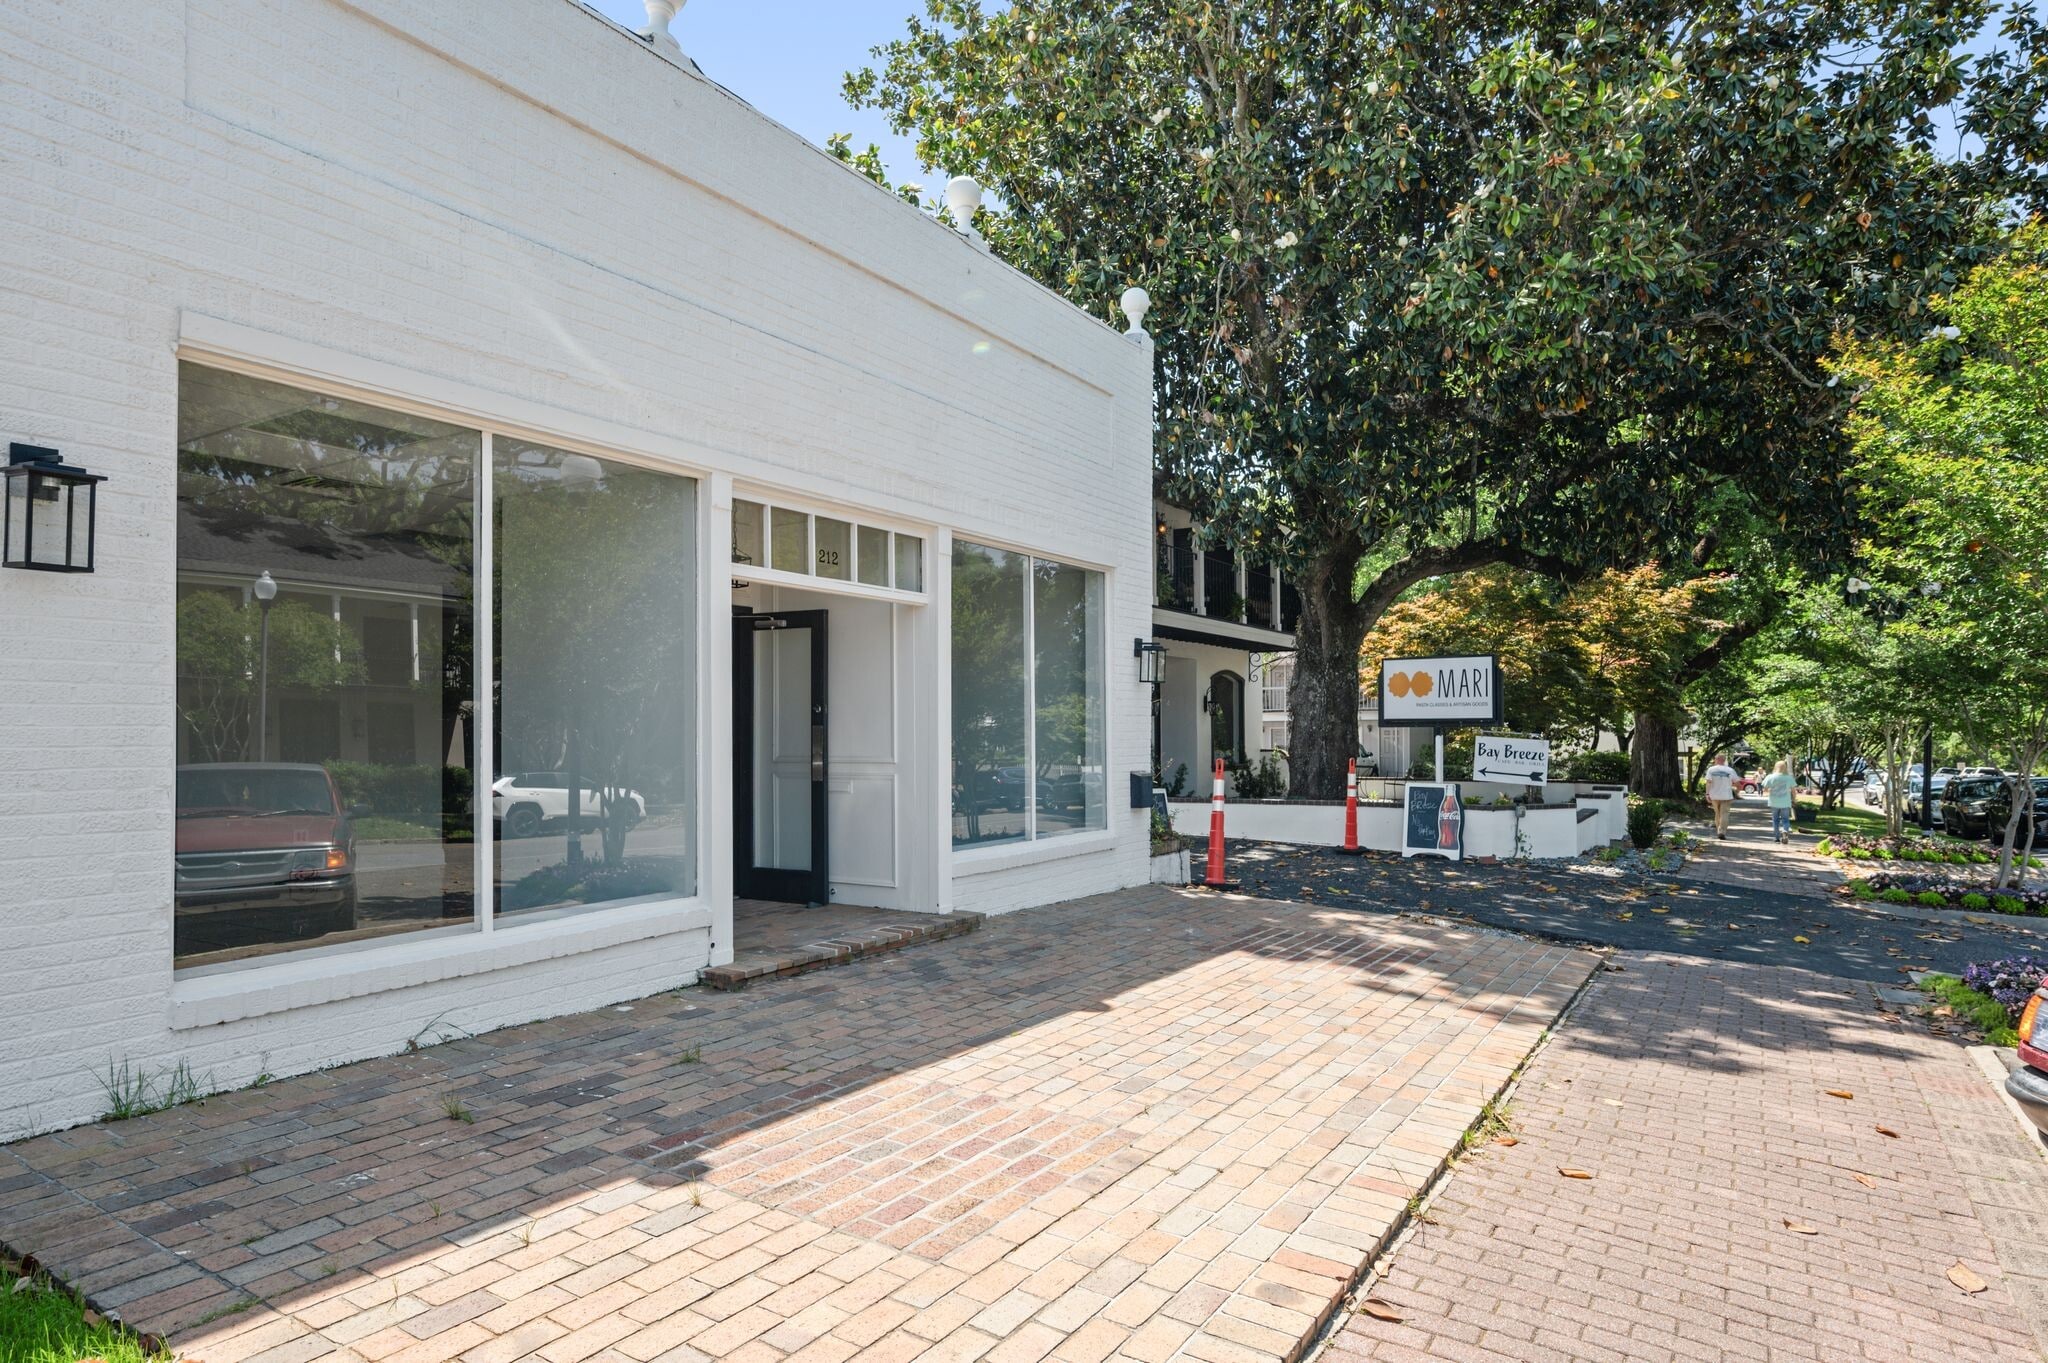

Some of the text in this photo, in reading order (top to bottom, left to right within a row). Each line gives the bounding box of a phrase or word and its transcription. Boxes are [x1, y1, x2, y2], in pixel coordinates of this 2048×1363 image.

[819, 549, 839, 566] 212
[1438, 668, 1489, 698] MARI
[1478, 743, 1545, 761] Bay Breeze
